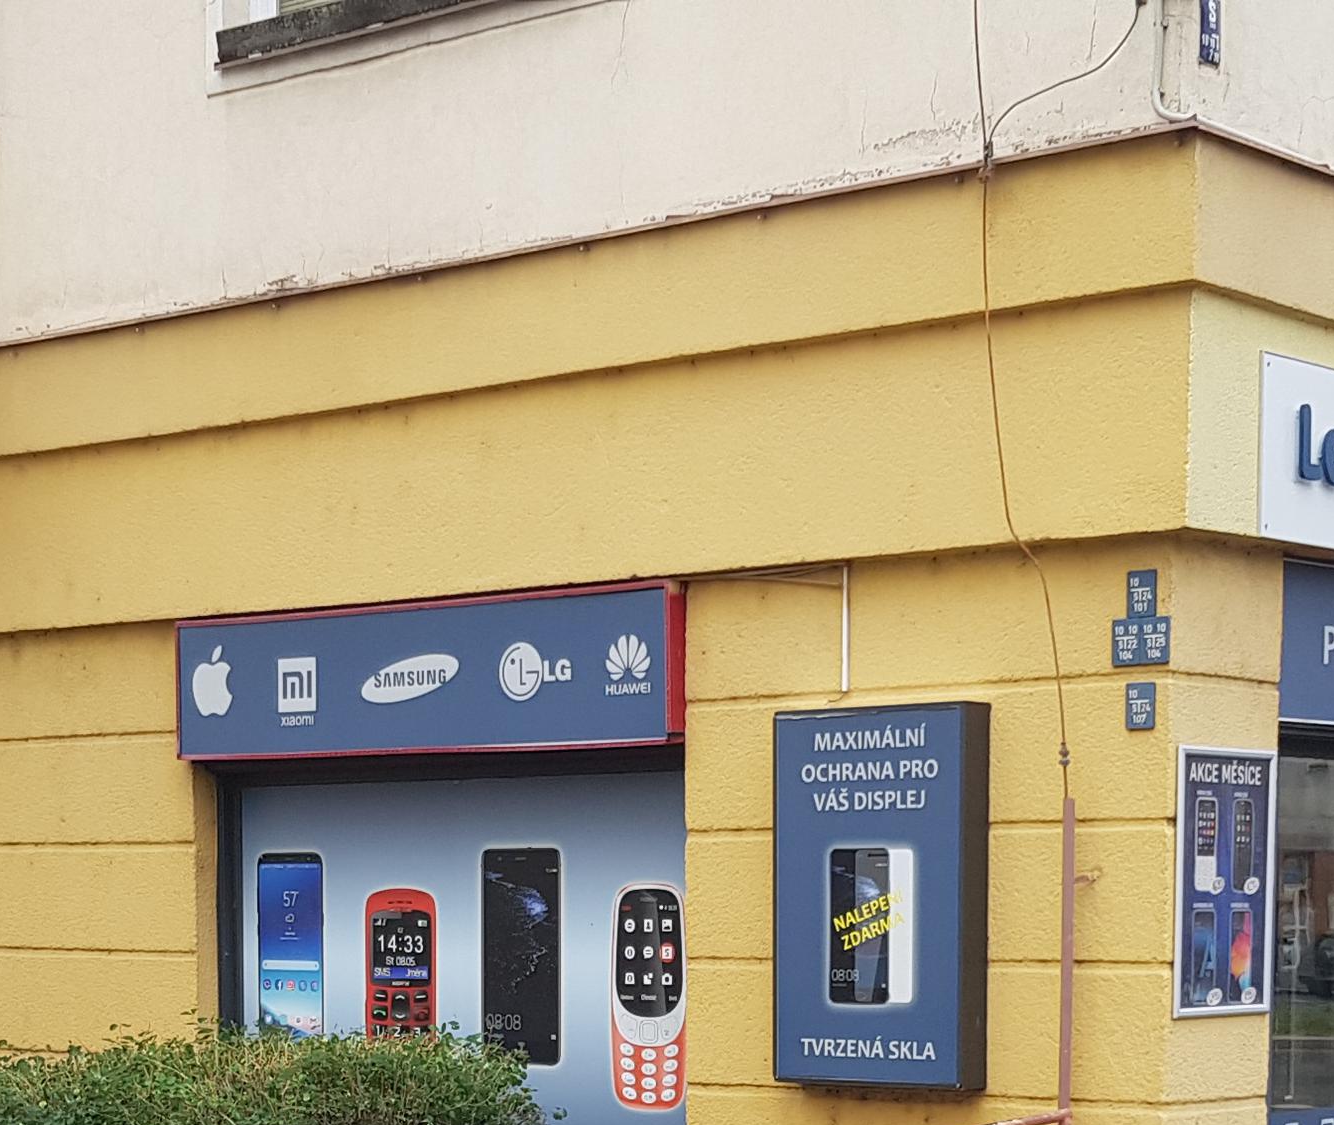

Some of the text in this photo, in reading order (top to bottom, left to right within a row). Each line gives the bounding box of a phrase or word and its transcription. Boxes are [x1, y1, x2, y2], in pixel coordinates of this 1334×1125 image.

[1129, 577, 1140, 588] 10
[1114, 624, 1139, 636] 10 10
[1143, 622, 1167, 634] 10 10
[373, 668, 449, 690] SAMSUNG
[543, 657, 573, 683] LG
[604, 681, 652, 697] HUAWEI
[1128, 688, 1138, 699] 10
[279, 714, 316, 728] xiaomi
[813, 722, 927, 753] MAXIMÁLNÍ
[800, 758, 940, 784] OCHRANA PRO
[1189, 758, 1263, 786] AKCE MĚSÍCE
[813, 787, 927, 813] VÁŠ DISPLEJ
[377, 934, 424, 953] 14:33
[800, 1034, 937, 1062] TVRZENÁ SKLA
